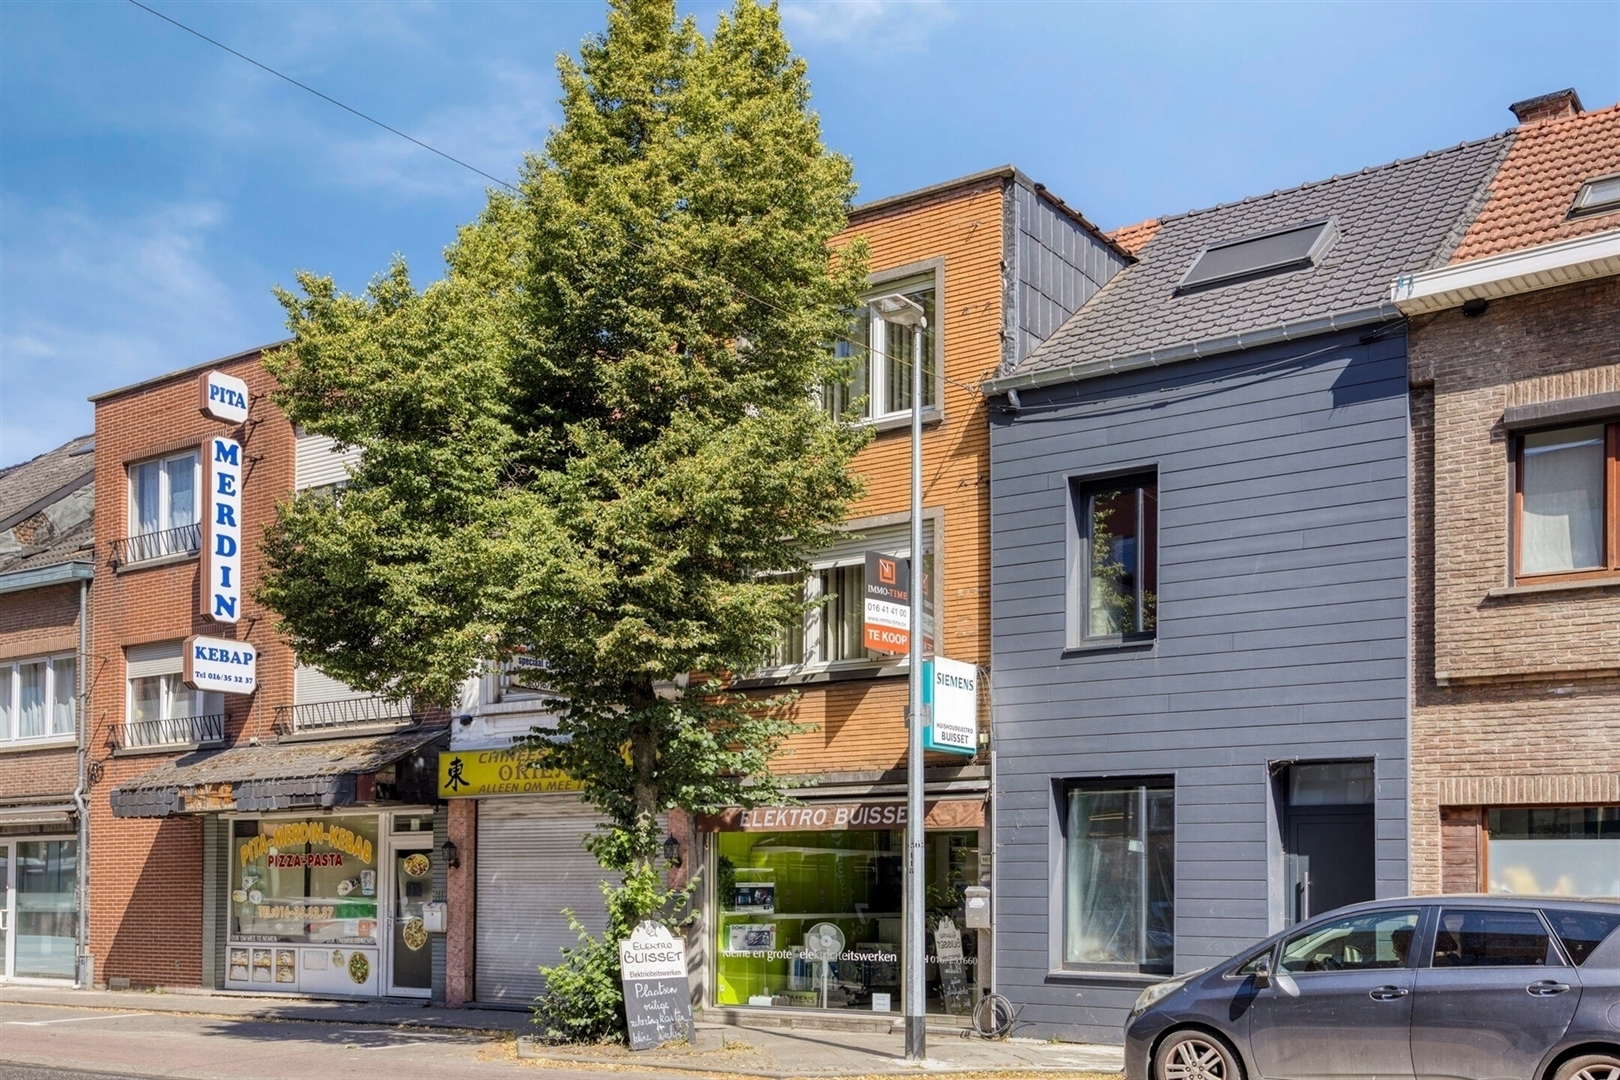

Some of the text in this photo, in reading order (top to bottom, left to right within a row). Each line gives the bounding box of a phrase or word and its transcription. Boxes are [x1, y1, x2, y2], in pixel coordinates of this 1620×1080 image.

[209, 383, 247, 410] PITA
[214, 440, 239, 619] MERDIN
[867, 584, 908, 600] IMMO-TIME
[867, 603, 880, 612] 016
[881, 605, 889, 614] 41
[899, 609, 907, 618] 00
[867, 629, 908, 645] TE KOOP
[195, 646, 253, 666] KEBAP
[195, 671, 206, 679] Tel
[208, 673, 232, 682] 016/35
[234, 675, 243, 683] 32
[936, 672, 974, 692] SIEMENS
[941, 731, 969, 744] BUISSET
[444, 757, 470, 792] 東
[498, 764, 571, 781] ORIEN
[479, 783, 519, 793] ALLEEN
[524, 782, 542, 792] OM
[546, 780, 571, 791] MEE
[740, 805, 909, 828] ELEKTRO BUISSE
[240, 822, 372, 867] PITA-MERDIN-KEBAB
[267, 853, 343, 868] PIZZA-PASTA
[633, 942, 673, 950] ELEKTRO
[624, 951, 682, 964] BUISSET
[752, 950, 764, 958] en
[767, 949, 792, 962] grote
[800, 948, 897, 962] elektriciteitswerken
[630, 970, 682, 978] Elektriciteitswerken
[635, 982, 677, 998] Plaatsen
